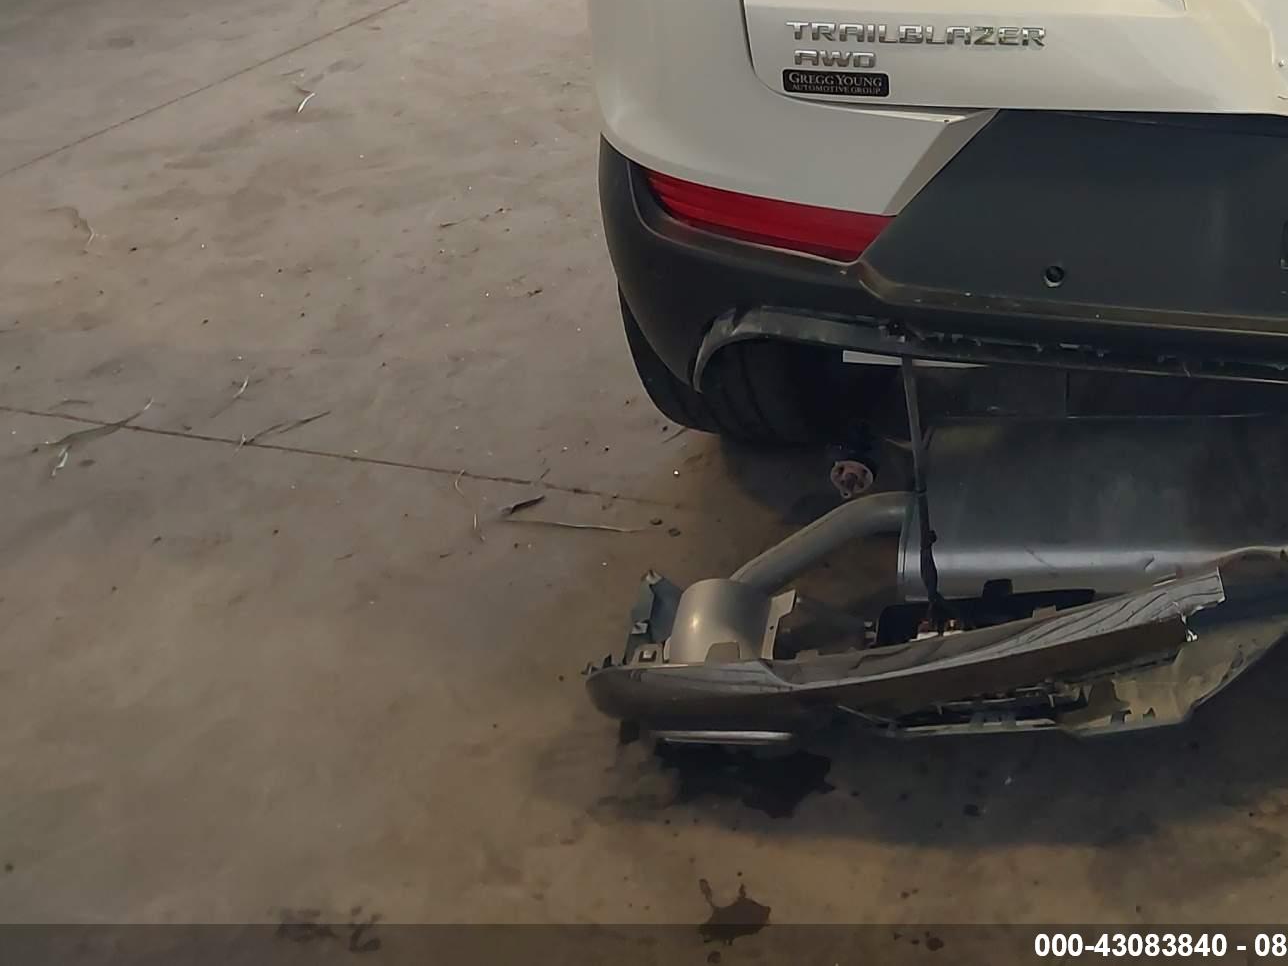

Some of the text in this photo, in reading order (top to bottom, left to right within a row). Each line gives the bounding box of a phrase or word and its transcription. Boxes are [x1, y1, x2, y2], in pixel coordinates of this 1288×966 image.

[786, 21, 1047, 47] TRAILBLAZER
[793, 49, 877, 68] AWD
[788, 72, 882, 87] GREGG YOUNG
[792, 84, 881, 95] AUTOMOTIVE GROUP
